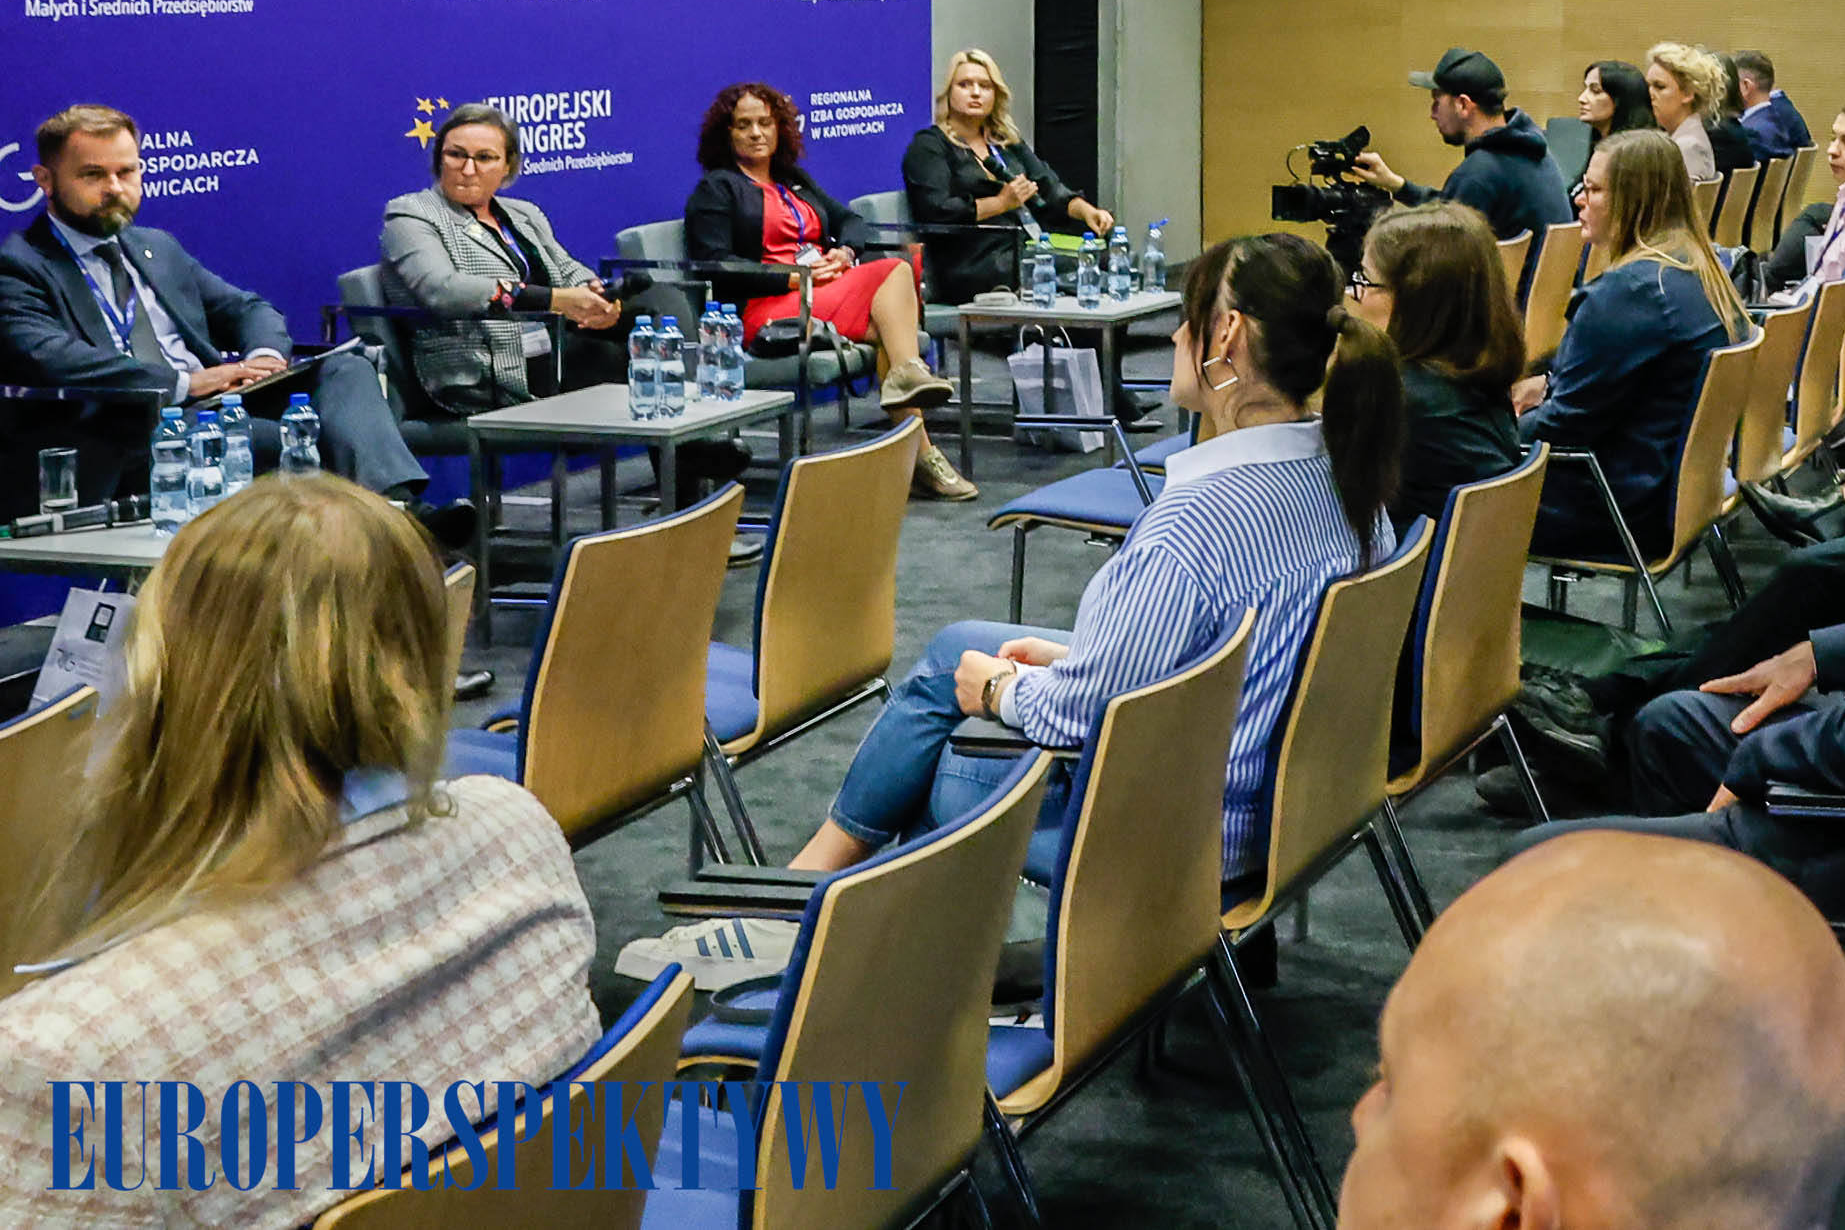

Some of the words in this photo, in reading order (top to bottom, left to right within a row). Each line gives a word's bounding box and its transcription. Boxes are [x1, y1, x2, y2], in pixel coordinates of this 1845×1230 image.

[810, 89, 872, 106] REGIONALNA
[810, 109, 833, 123] IZBA
[835, 103, 904, 120] GOSPODARCZA
[518, 121, 586, 154] NGRES
[811, 127, 821, 140] W
[823, 121, 885, 138] KATOWICACH
[143, 175, 219, 198] WICACH
